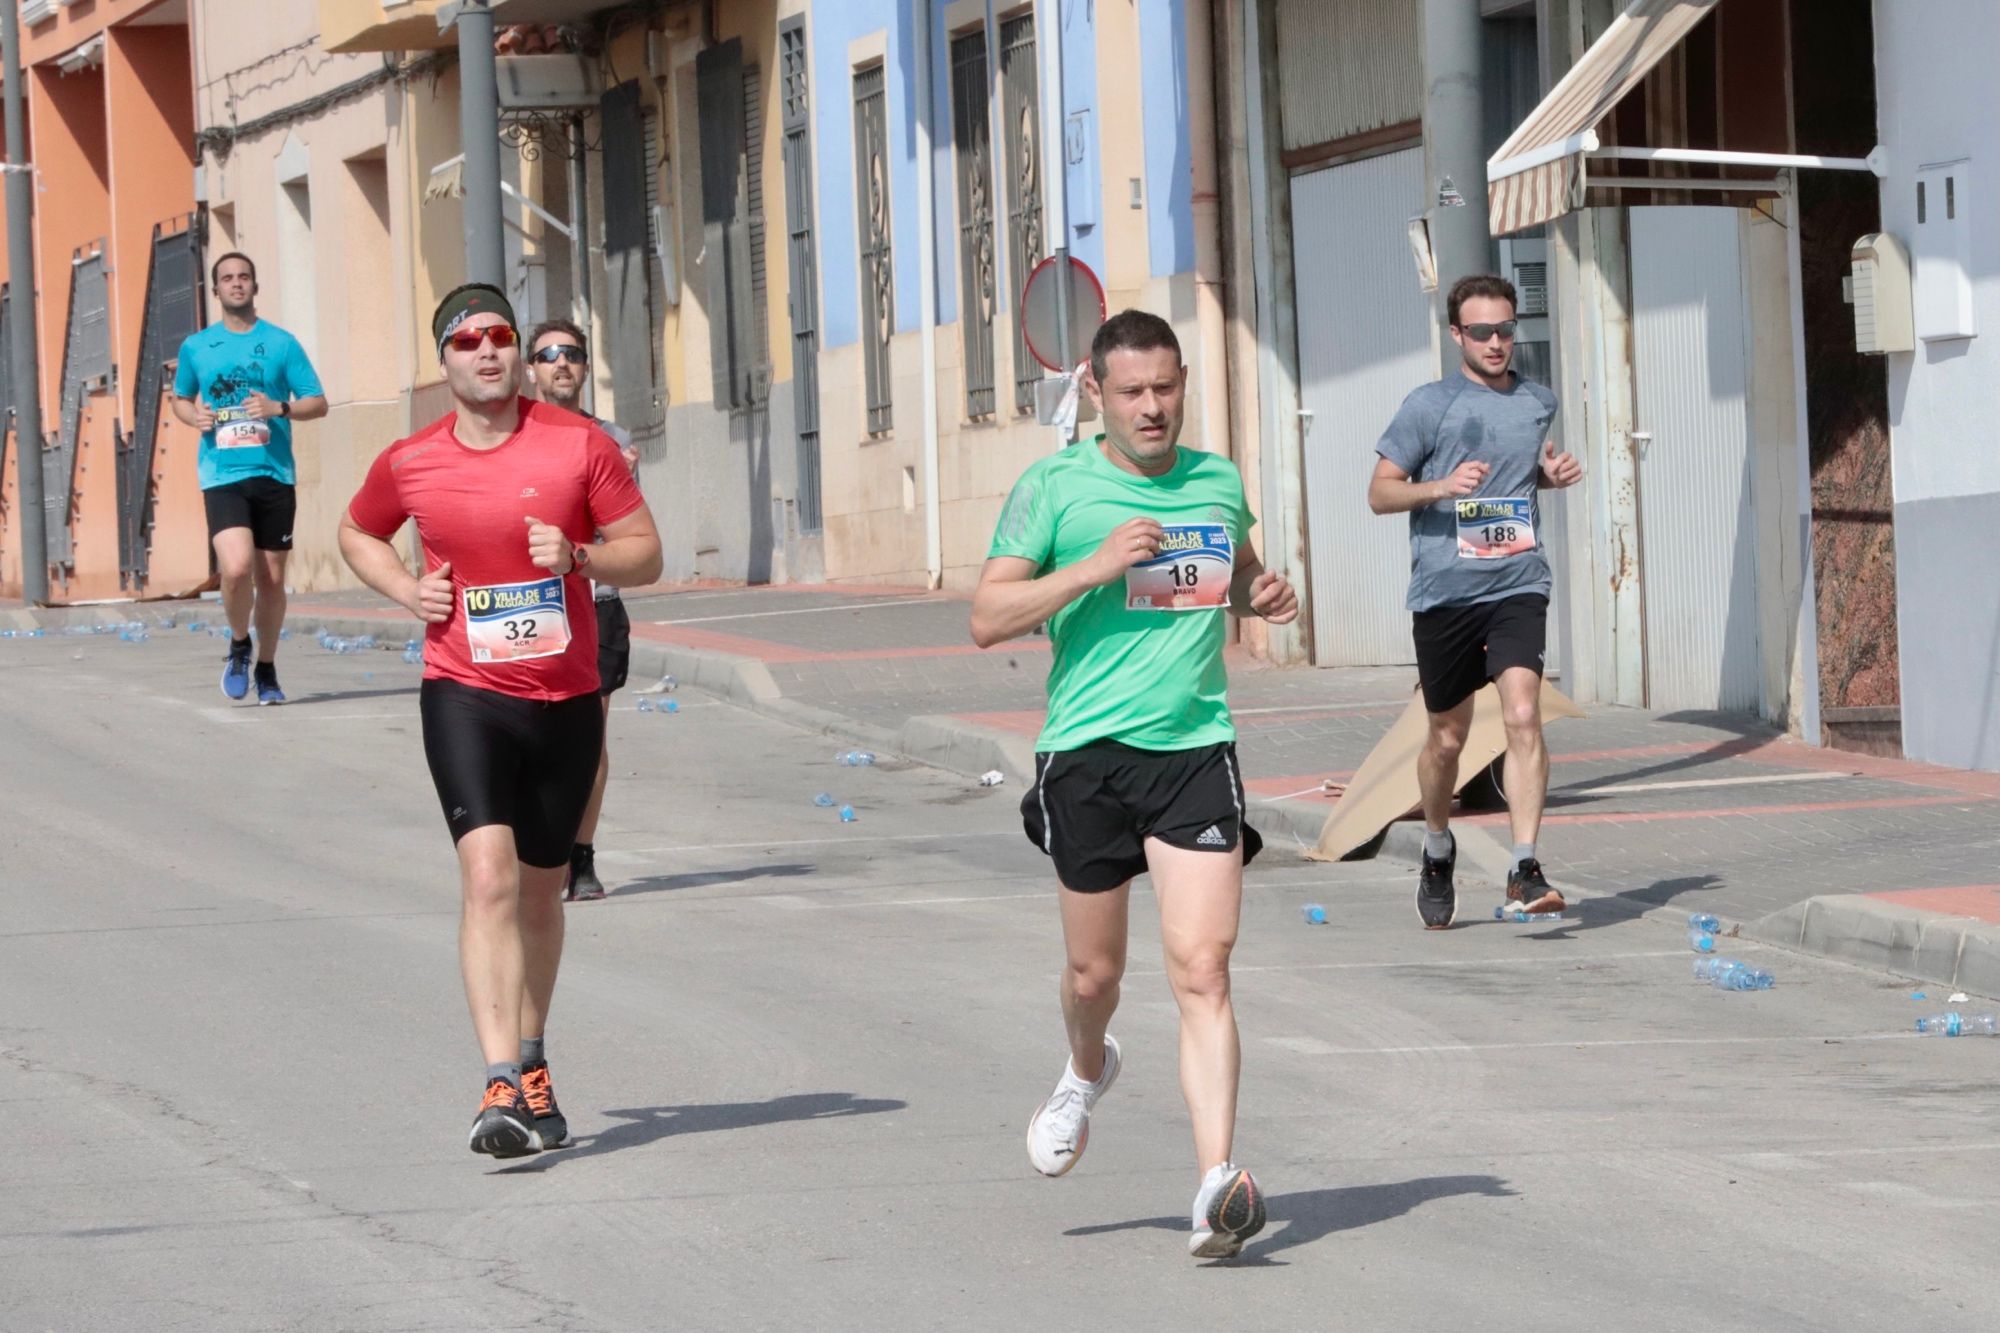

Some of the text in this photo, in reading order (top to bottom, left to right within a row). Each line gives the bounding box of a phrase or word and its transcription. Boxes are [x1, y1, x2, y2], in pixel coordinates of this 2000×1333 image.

[232, 425, 256, 437] 154
[1187, 531, 1202, 542] DE
[1481, 526, 1516, 542] 188
[1159, 540, 1204, 550] ALGUAZAS
[1169, 564, 1198, 587] 18
[494, 590, 523, 602] VILLA
[525, 588, 540, 600] DE
[504, 619, 538, 640] 32
[1197, 837, 1226, 845] adidas
